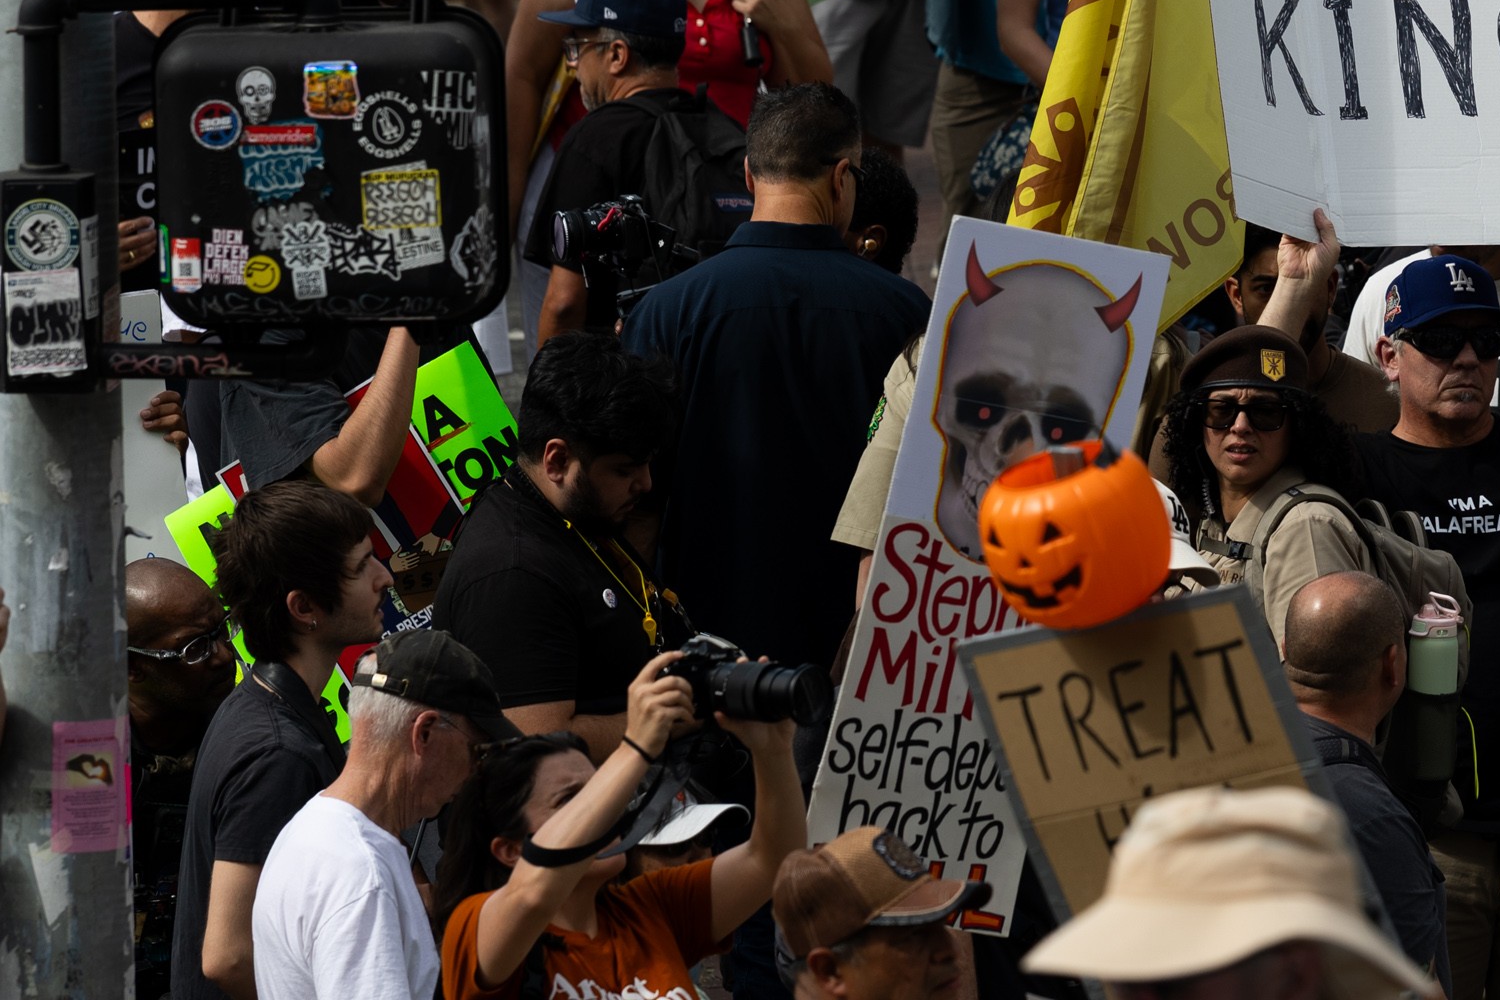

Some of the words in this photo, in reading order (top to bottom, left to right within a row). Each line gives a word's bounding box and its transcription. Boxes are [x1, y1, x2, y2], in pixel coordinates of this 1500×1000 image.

[352, 90, 418, 131] EGGSHELLS
[358, 119, 422, 159] EGGSHELLS
[1446, 263, 1476, 293] LA
[422, 394, 466, 441] A
[1479, 494, 1493, 509] A
[996, 637, 1255, 783] TREAT
[838, 774, 955, 860] back
[957, 800, 1005, 861] to
